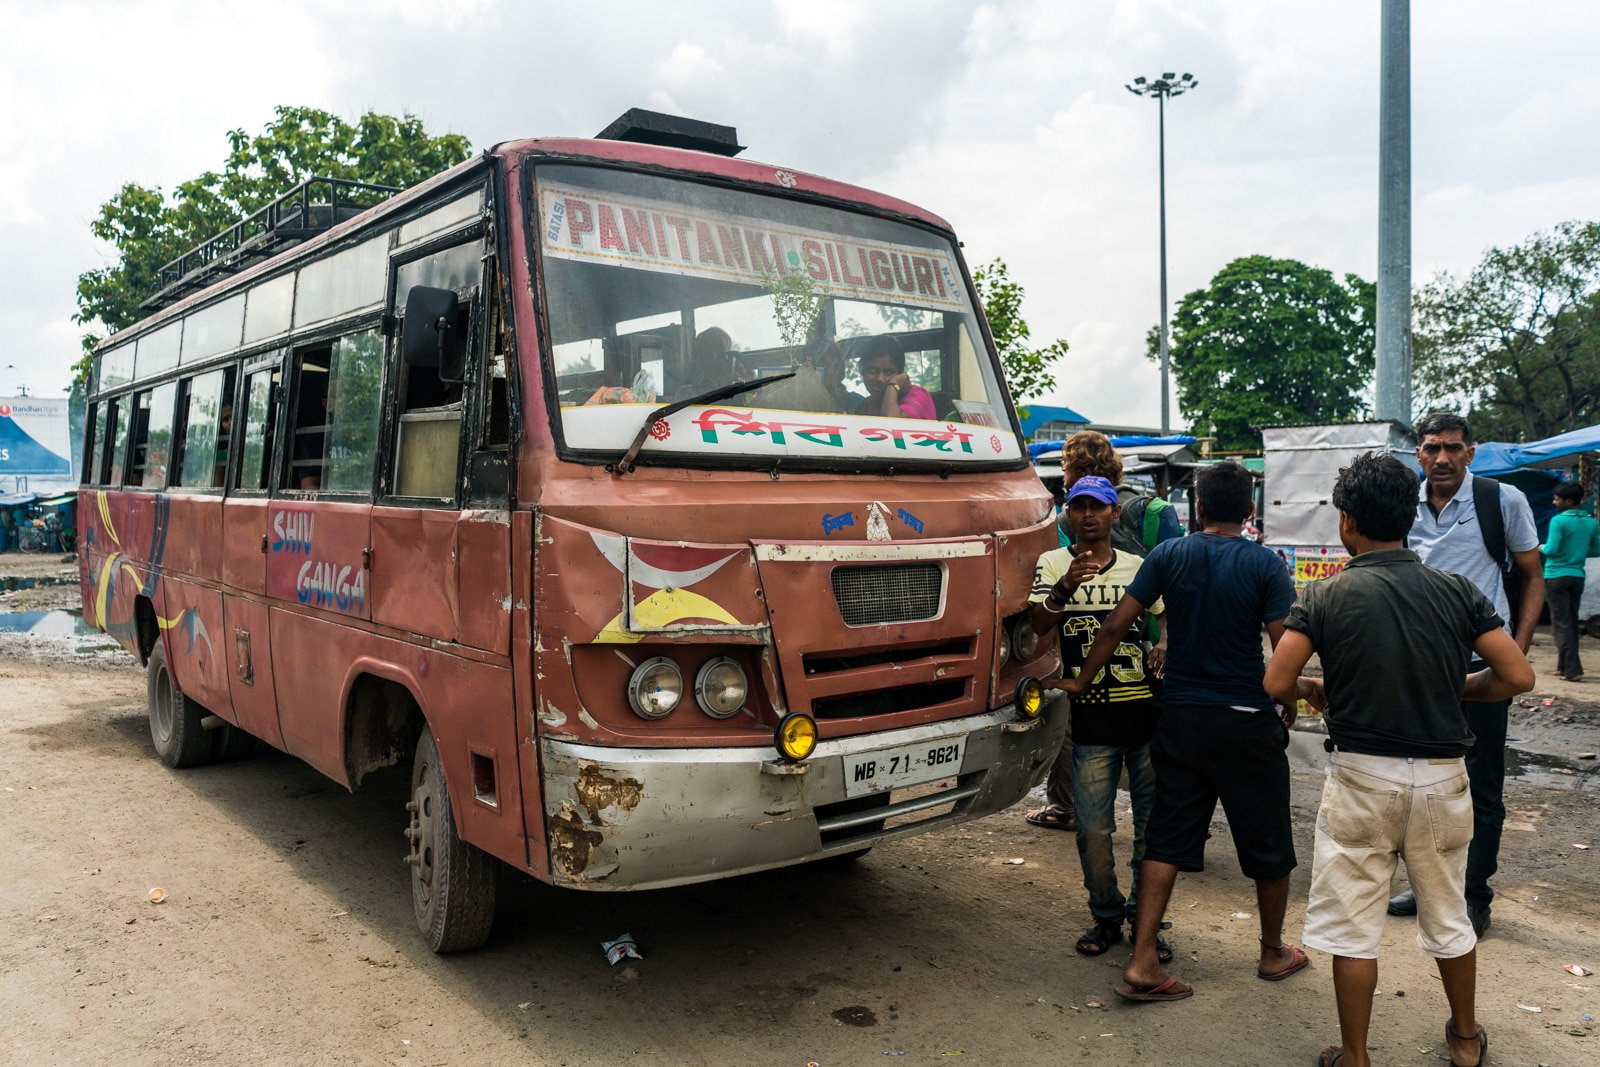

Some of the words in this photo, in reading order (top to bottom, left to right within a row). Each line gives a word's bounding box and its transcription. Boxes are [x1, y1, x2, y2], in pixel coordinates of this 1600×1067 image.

[547, 202, 565, 242] BATASI
[564, 198, 787, 276] PANITANKI
[802, 240, 947, 298] SILIGURI
[691, 408, 848, 448] শিব
[272, 510, 315, 555] SHIV
[297, 560, 365, 614] GANGA
[854, 761, 876, 782] WB
[889, 754, 910, 774] 71
[927, 744, 959, 767] 9621
